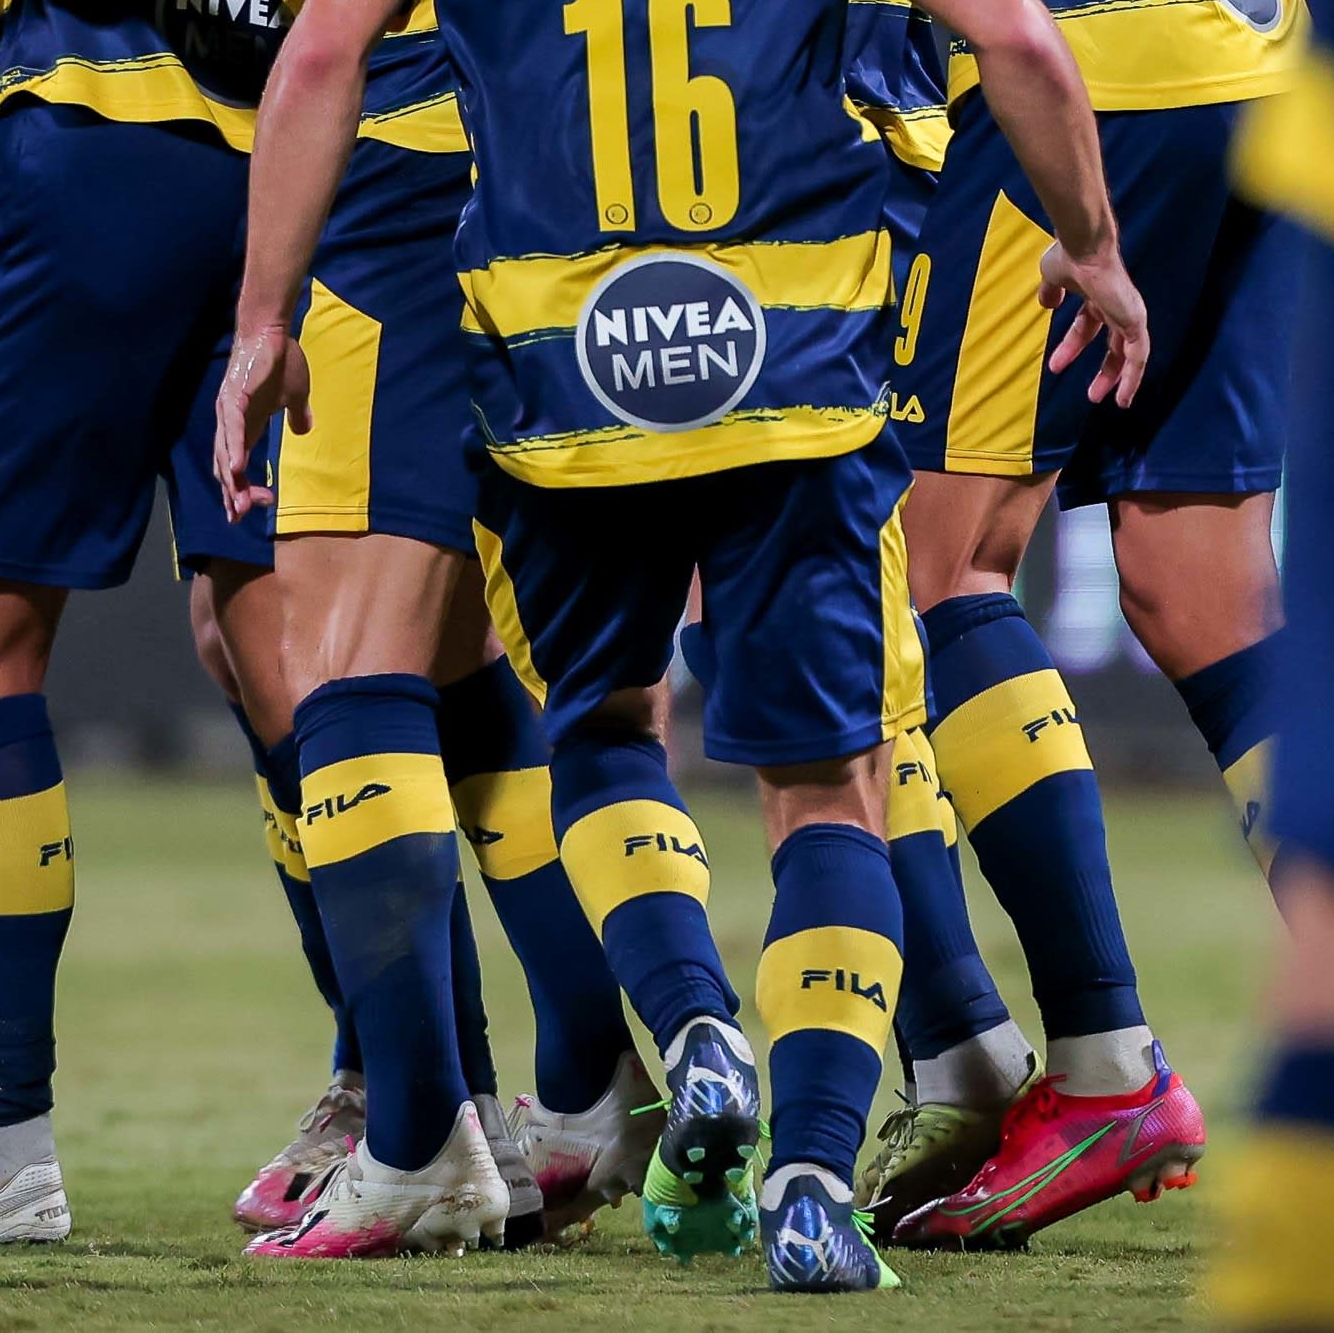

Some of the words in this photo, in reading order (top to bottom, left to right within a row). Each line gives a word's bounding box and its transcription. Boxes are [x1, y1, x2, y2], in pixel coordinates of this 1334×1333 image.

[594, 301, 753, 347] NIVEA
[894, 253, 931, 366] 9
[612, 340, 739, 391] MEN
[890, 392, 925, 423] LA
[1021, 708, 1079, 743] FIL
[307, 784, 391, 826] FILA
[40, 836, 73, 866] FI
[624, 832, 709, 870] FILA
[801, 969, 887, 1013] FILA
